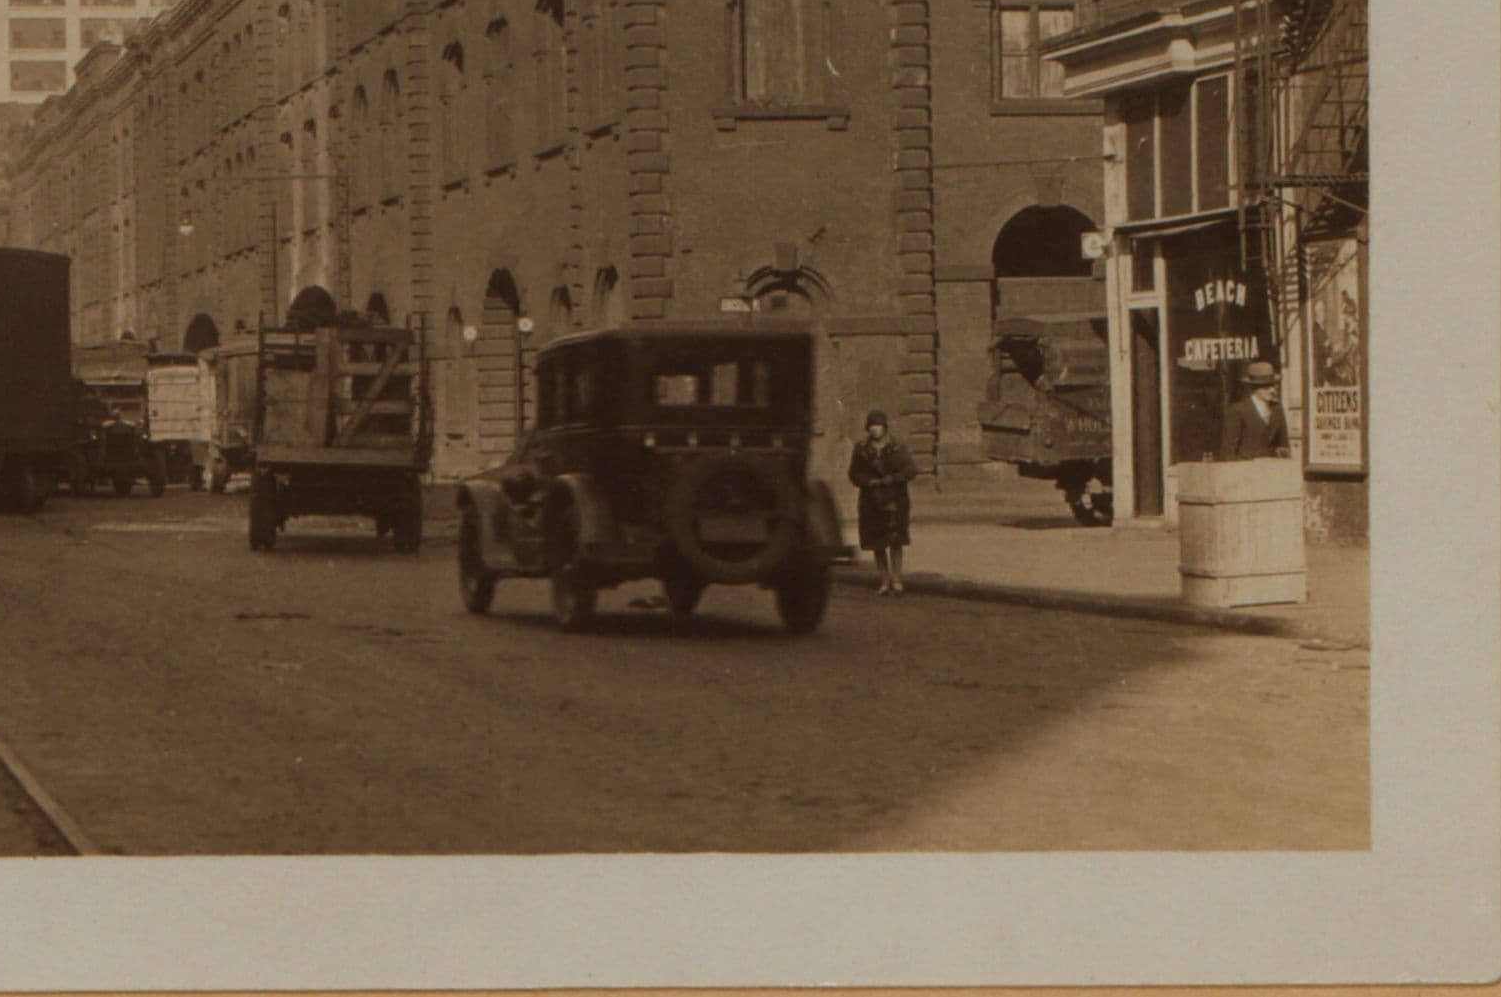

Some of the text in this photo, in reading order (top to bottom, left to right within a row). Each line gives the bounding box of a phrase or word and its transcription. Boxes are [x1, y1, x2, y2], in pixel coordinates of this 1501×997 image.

[1195, 279, 1247, 312] BEACH
[1184, 336, 1260, 361] CAFETERIA
[1316, 390, 1359, 413] CITIZENS
